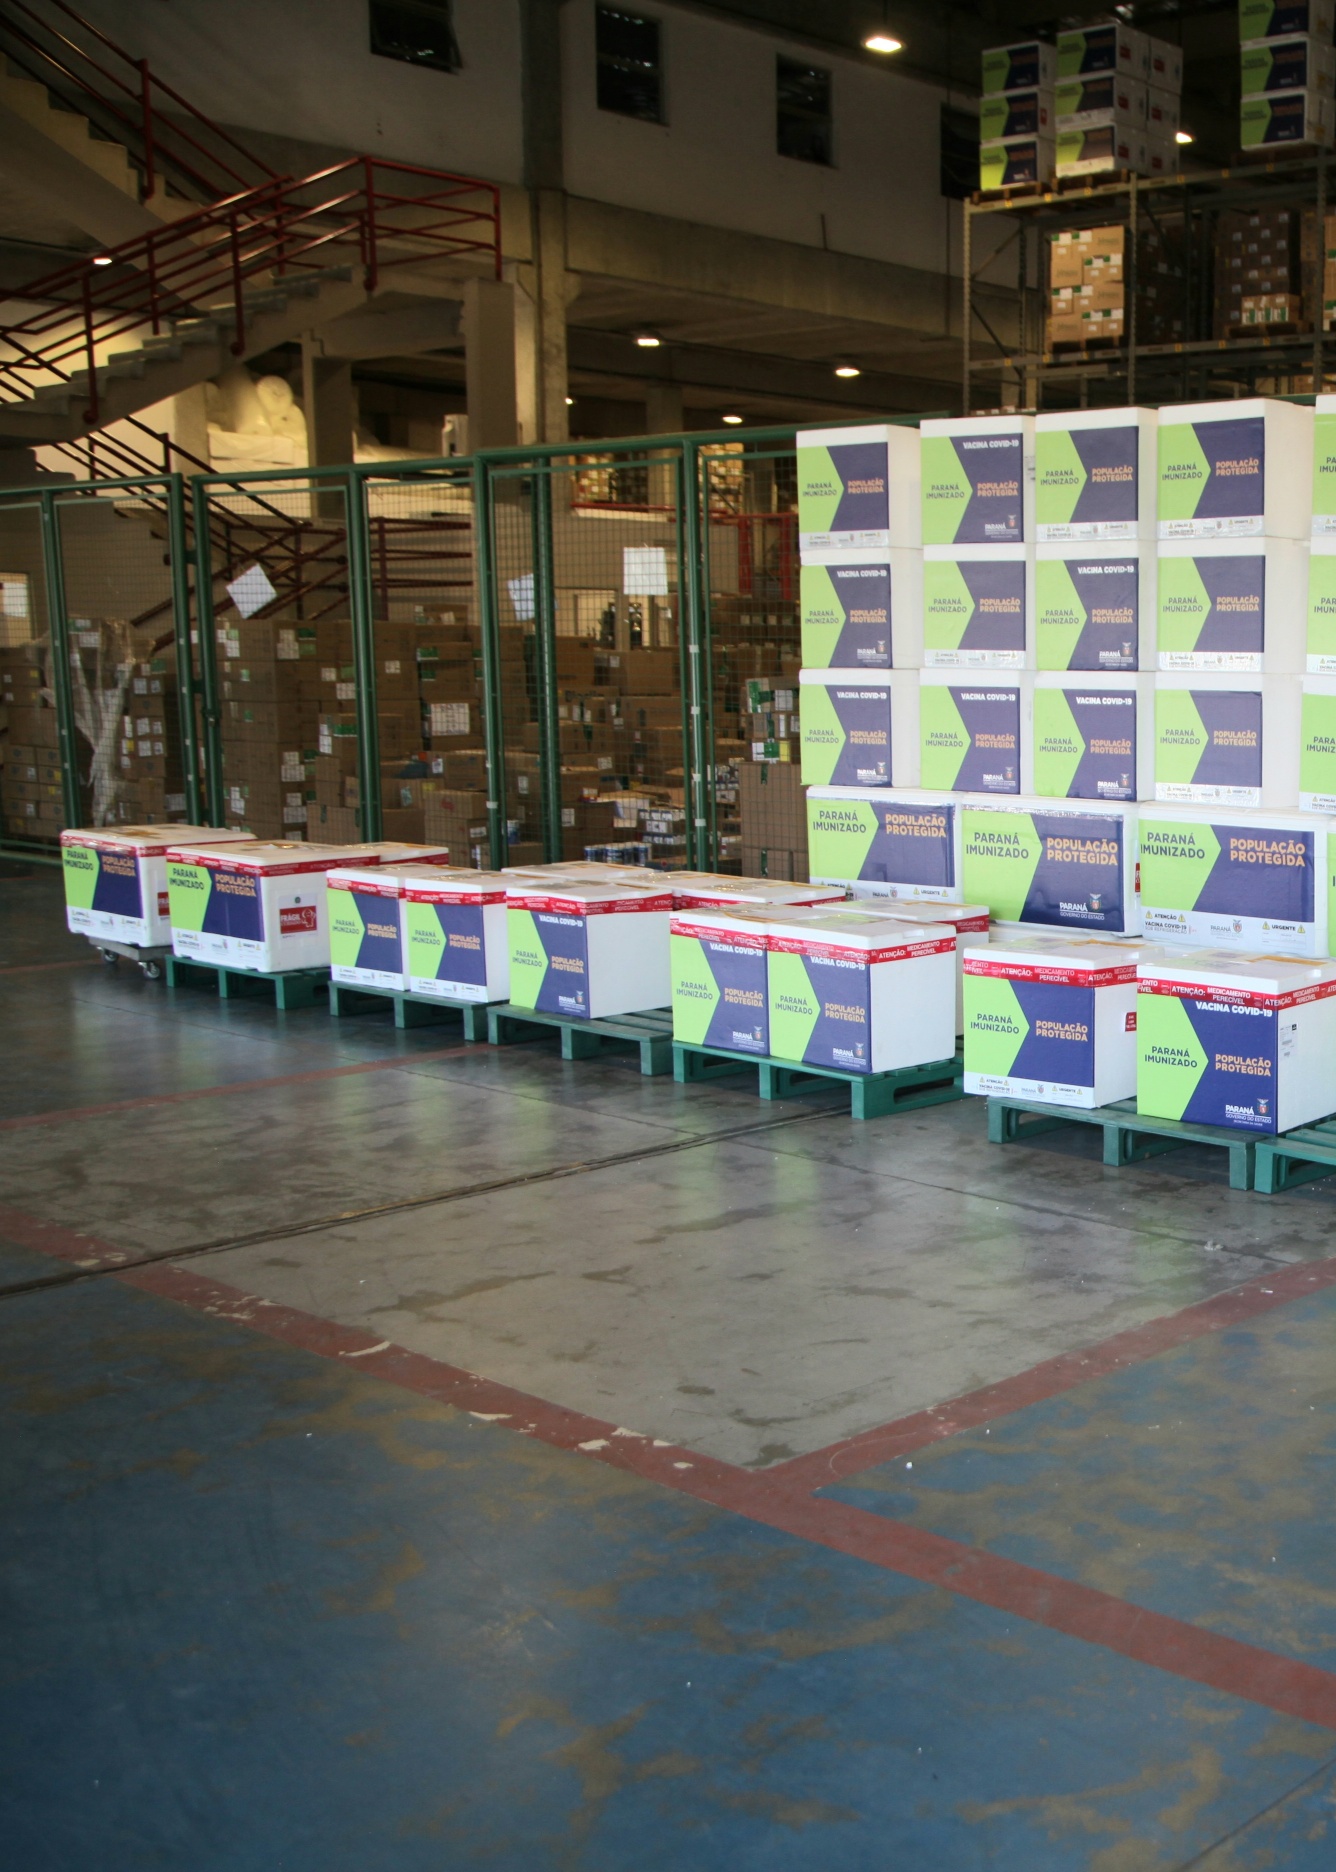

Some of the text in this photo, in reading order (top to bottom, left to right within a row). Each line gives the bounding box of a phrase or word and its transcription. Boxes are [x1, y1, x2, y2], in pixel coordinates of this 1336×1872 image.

[963, 439, 1019, 449] VACINA COVID-19
[848, 478, 884, 487] POPULAÇÃO
[931, 483, 960, 492] PARANÁ
[977, 480, 1018, 490] POPULAÇÃO
[802, 488, 837, 497] IMUNIZADO
[848, 486, 884, 494] PROTEGIDA
[926, 490, 965, 500] IMUNIZADO
[977, 488, 1018, 497] PROTEGIDA
[930, 732, 958, 740] PARANÁ
[975, 733, 1016, 741] POPULAÇÃO
[925, 739, 964, 748] IMUNIZADO
[975, 740, 1016, 749] PROTEGIDA
[819, 810, 858, 821] PARANÁ
[885, 813, 946, 826] POPULAÇÃO
[813, 822, 867, 833] IMUNIZADO
[886, 825, 946, 838] PROTEGIDA
[974, 832, 1020, 845] PARANÁ
[1147, 832, 1195, 845] PARANÁ
[966, 844, 1029, 859] IMUNIZADO
[1047, 837, 1118, 854] POPULAÇÃO
[1140, 844, 1205, 859] IMUNIZADO
[1230, 838, 1305, 855] POPULAÇÃO
[67, 850, 88, 860] PARANÁ
[1047, 850, 1118, 866] PROTEGIDA
[1230, 851, 1305, 867] PROTEGIDA
[64, 860, 94, 871] IMUNIZADO
[102, 856, 135, 868] POPULAÇÃO
[103, 863, 136, 877] PROTEGIDA
[172, 867, 198, 879] PARANÁ
[169, 878, 205, 890] IMUNIZADO
[215, 873, 255, 887] POPULAÇÃO
[215, 883, 256, 897] PROTEGIDA
[1059, 900, 1087, 912] PARANÁ
[415, 929, 437, 939] PARANÁ
[449, 934, 480, 943] POPULAÇÃO
[411, 936, 441, 946] IMUNIZADO
[449, 940, 481, 950] PROTEGIDA
[710, 943, 763, 957] VACINA COVID-19
[1001, 967, 1033, 977] ATENÇÃO:
[1034, 967, 1075, 976] MEDICAMENTO
[1039, 974, 1070, 983] PERECÍVEL
[681, 981, 707, 991] PARANÁ
[676, 989, 713, 1000] IMUNIZADO
[725, 987, 763, 1000] POPULAÇÃO
[725, 995, 763, 1008] PROTEGIDA
[1196, 1001, 1272, 1017] VACINA COVID-19
[977, 1013, 1012, 1024] PARANÁ
[971, 1021, 1019, 1034] IMUNIZADO
[1036, 1020, 1088, 1033] POPULAÇÃO
[1036, 1028, 1088, 1042] PROTEGIDA
[1151, 1046, 1190, 1058] PARANÁ
[1144, 1055, 1198, 1068] IMUNIZADO
[1215, 1054, 1272, 1068] POPULAÇÃO
[1215, 1062, 1271, 1076] PROTEGIDA
[1225, 1104, 1254, 1114] PARANÁ
